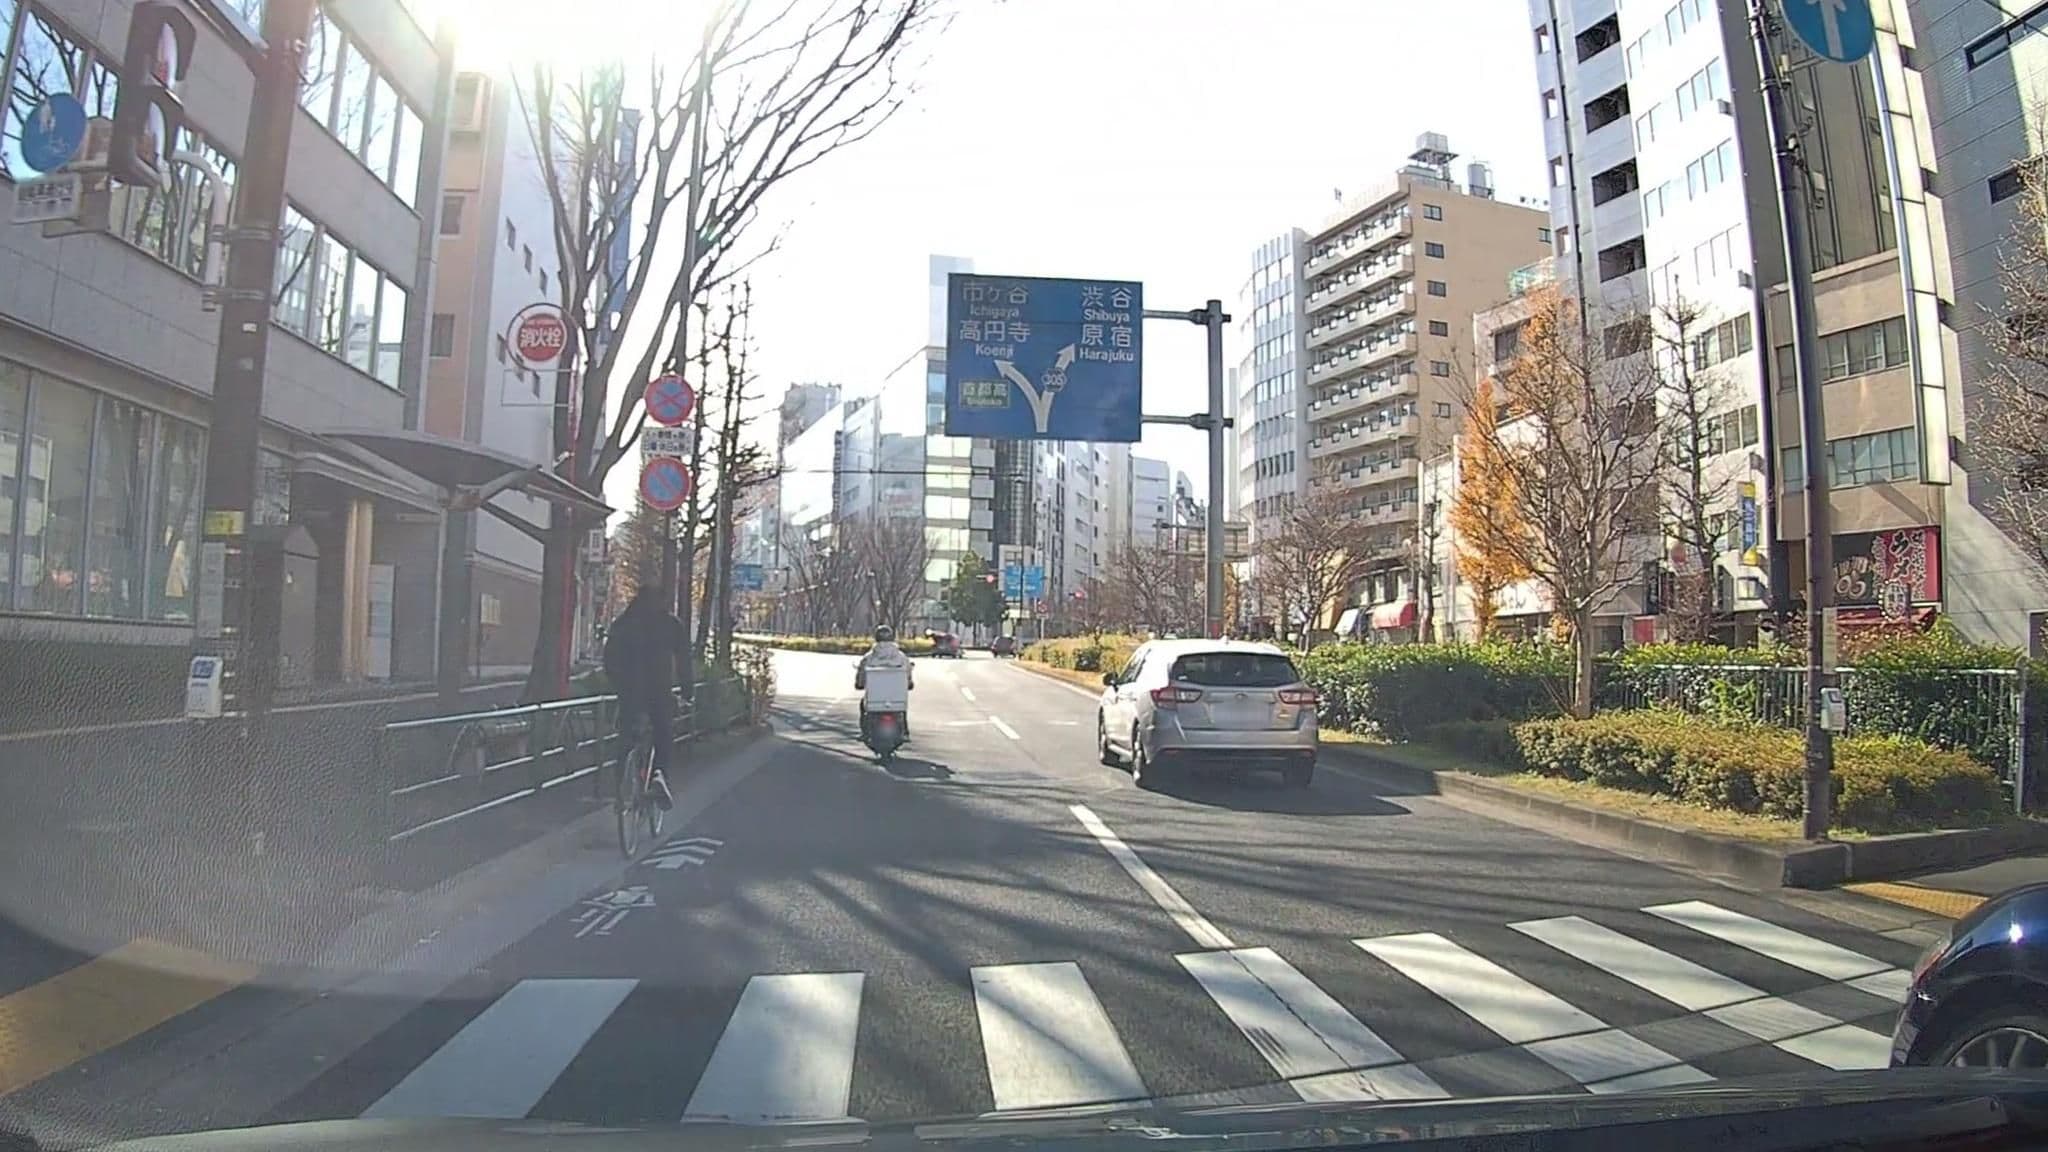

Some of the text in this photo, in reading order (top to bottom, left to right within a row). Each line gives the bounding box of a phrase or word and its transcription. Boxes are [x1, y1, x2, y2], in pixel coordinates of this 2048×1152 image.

[1082, 285, 1132, 308] 渋谷
[970, 304, 1019, 318] Ichigaya
[1084, 309, 1130, 323] Shibuya
[519, 327, 561, 348] 消火栓
[960, 320, 1031, 342] 高円寺
[1081, 324, 1132, 347] 原宿
[975, 343, 1013, 359] Koenji
[1079, 347, 1134, 363] Harajuku
